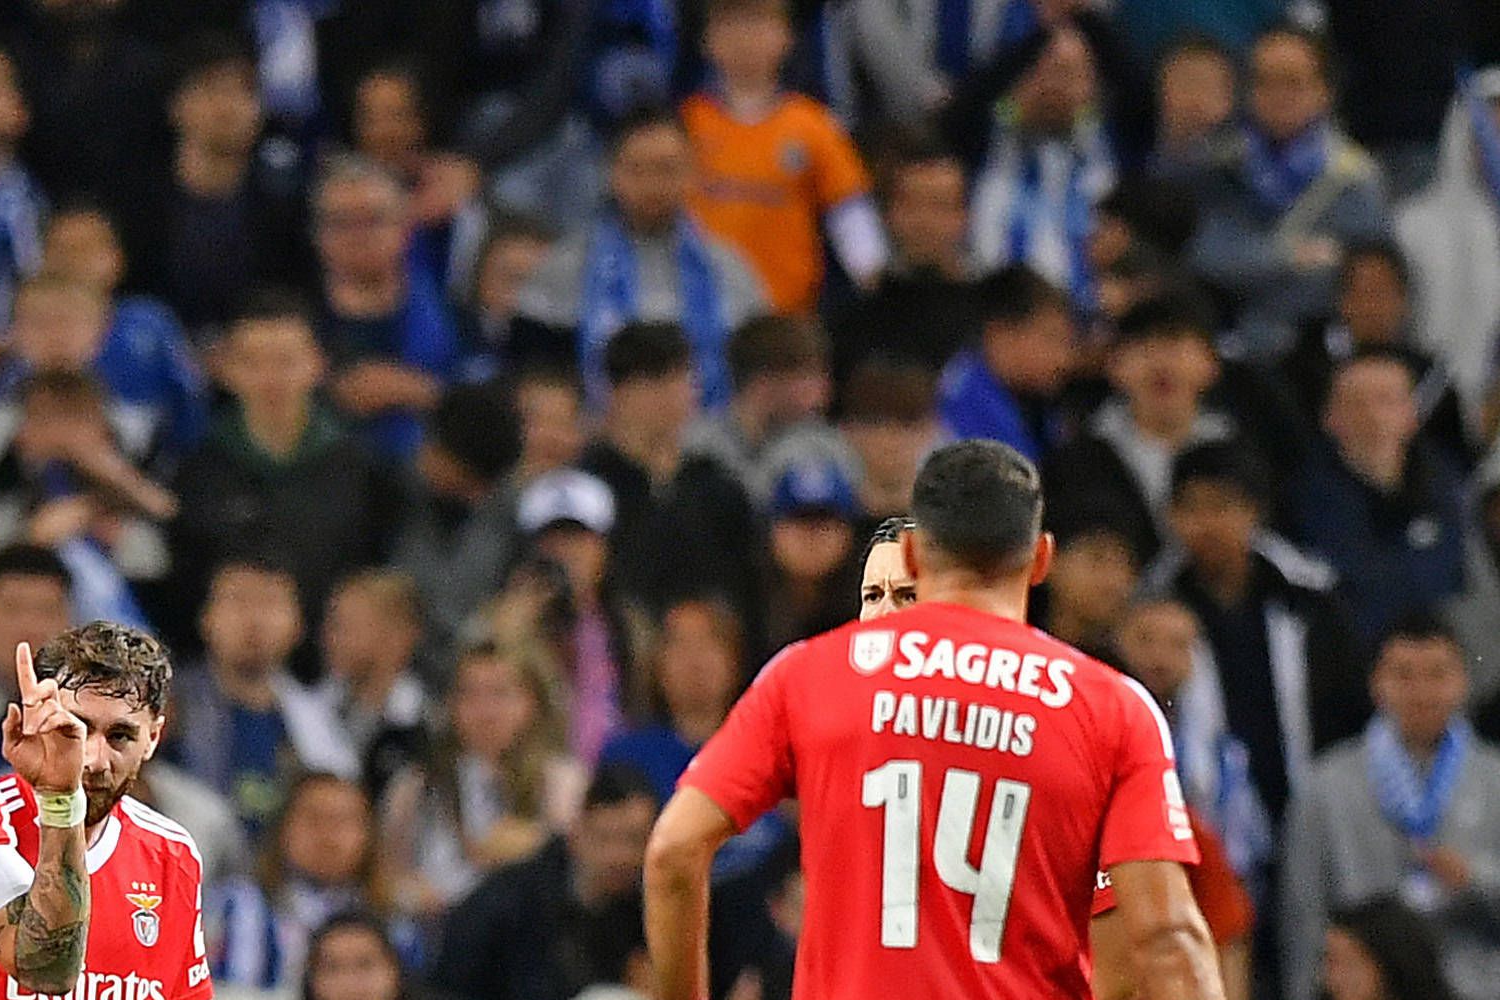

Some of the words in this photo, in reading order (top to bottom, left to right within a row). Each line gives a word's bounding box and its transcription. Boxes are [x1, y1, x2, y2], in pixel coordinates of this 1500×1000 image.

[893, 631, 1076, 708] SAGRES
[872, 690, 1037, 756] PAVLIDIS
[861, 760, 1031, 964] 14
